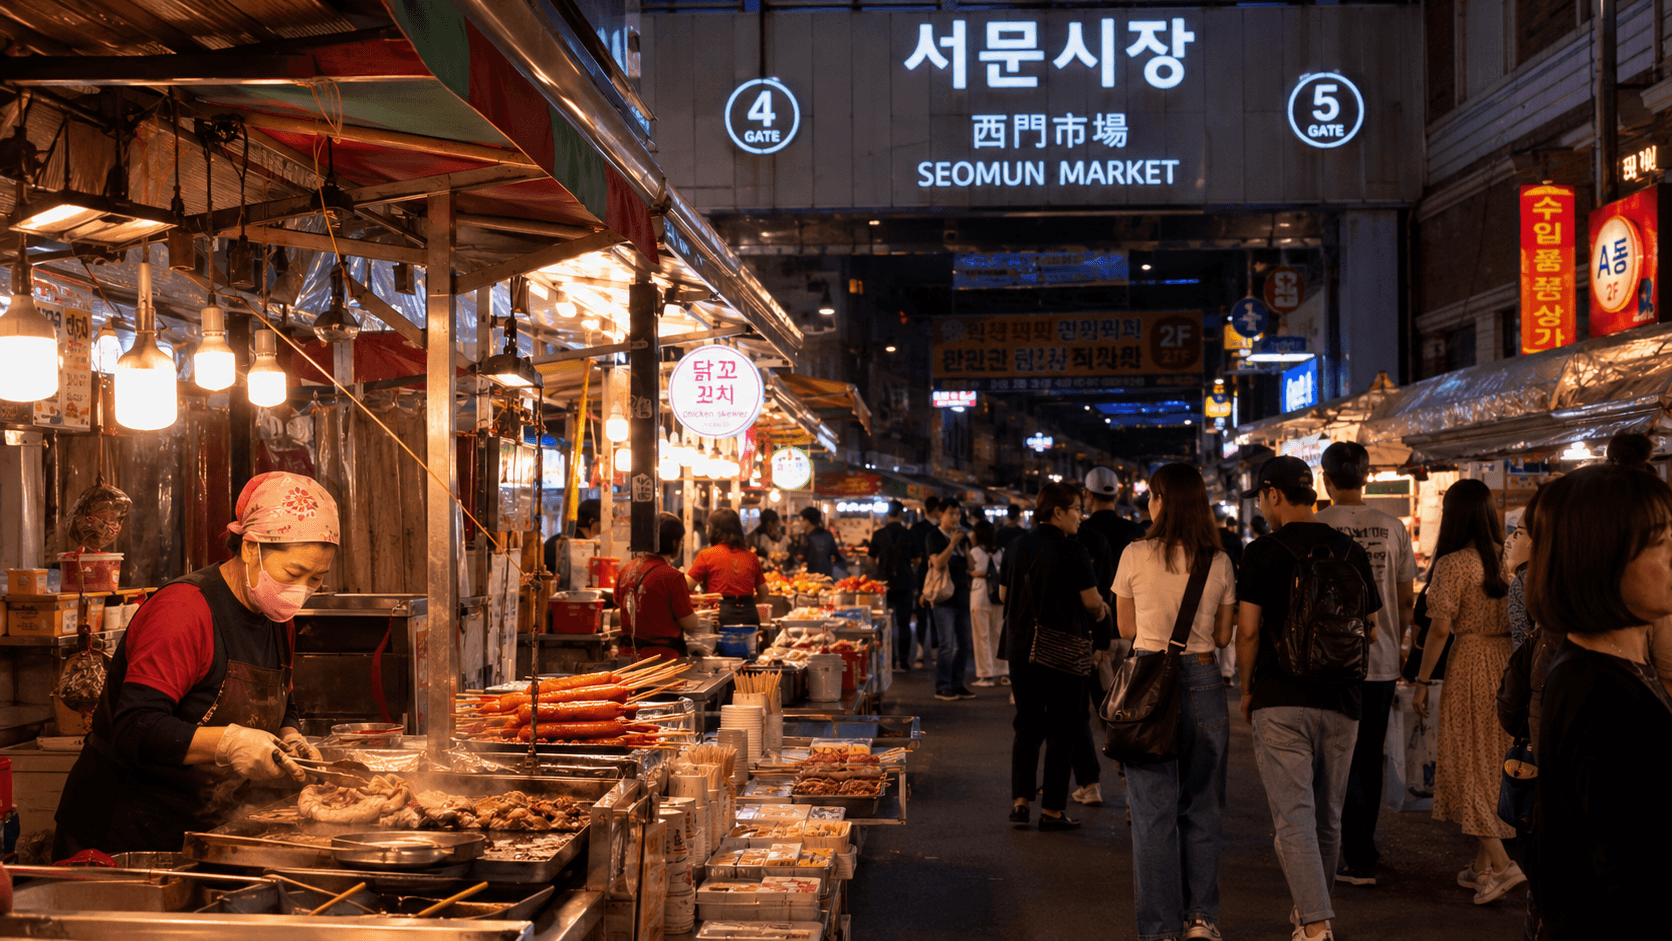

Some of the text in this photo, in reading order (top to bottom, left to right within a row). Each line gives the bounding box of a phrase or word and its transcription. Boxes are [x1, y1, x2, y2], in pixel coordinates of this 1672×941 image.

[904, 17, 1195, 90] 서문시장
[747, 90, 776, 127] 4
[1311, 83, 1339, 122] 5
[744, 130, 781, 143] GATE
[971, 112, 1129, 150] 西門市場
[1307, 124, 1345, 137] GATE
[918, 159, 1180, 188] SEOMUN MARKET
[1597, 237, 1629, 279] A동
[1605, 281, 1619, 302] 2F
[1159, 325, 1192, 348] 2F
[696, 384, 734, 406] 꼬치
